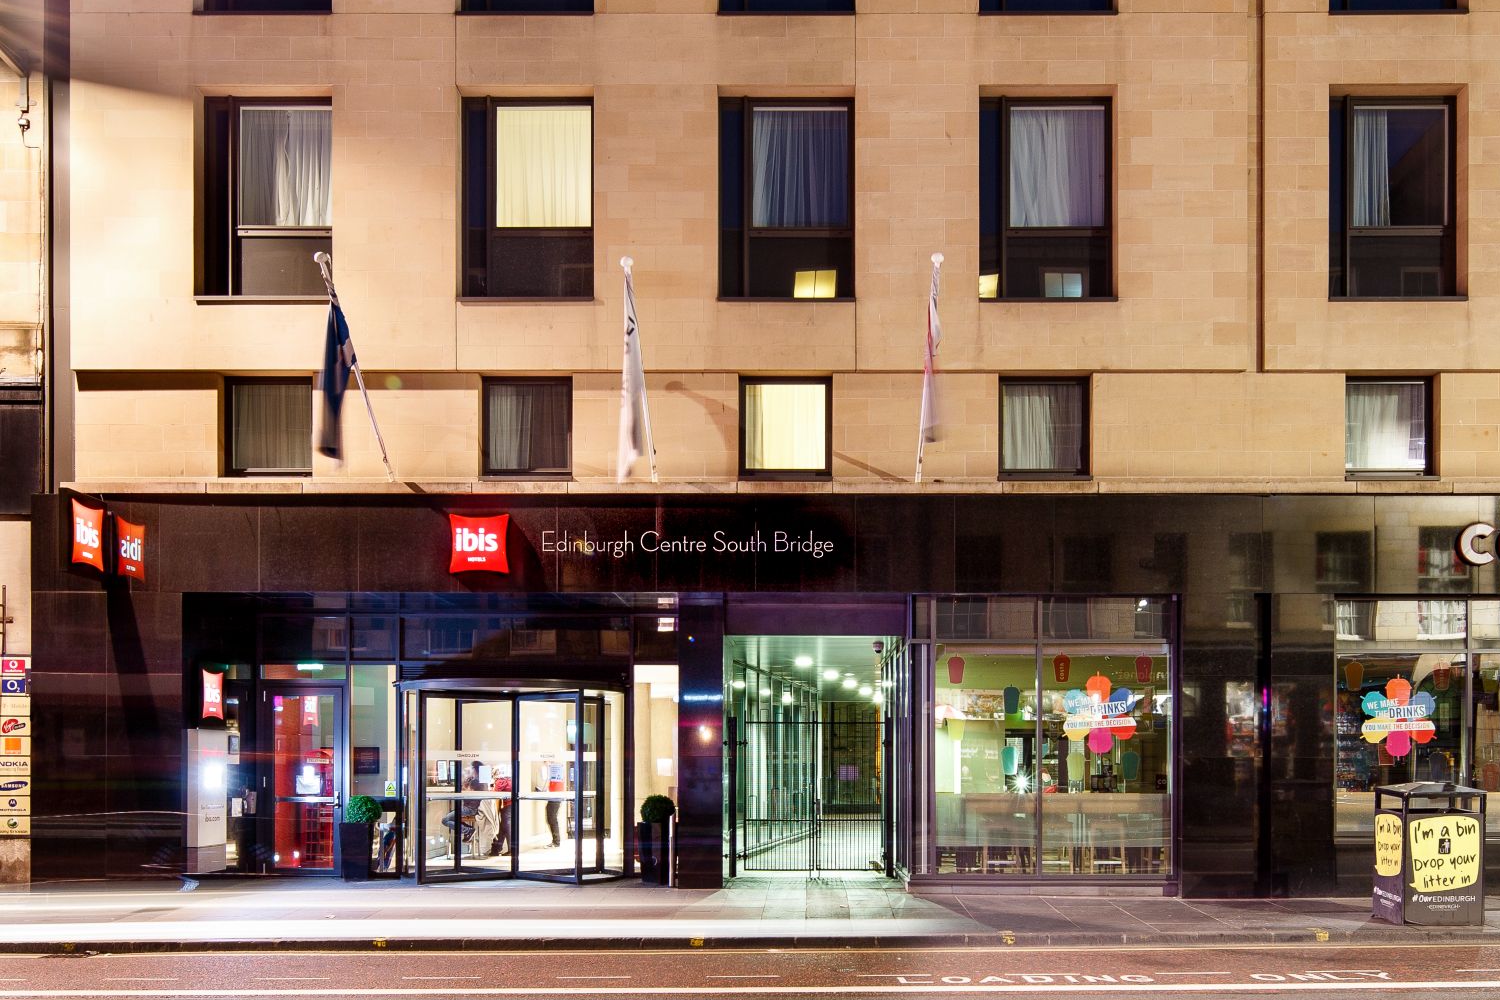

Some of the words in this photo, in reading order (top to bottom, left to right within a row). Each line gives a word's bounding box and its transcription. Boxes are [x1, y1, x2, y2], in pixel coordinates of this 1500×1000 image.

[75, 517, 99, 549] ibis
[455, 527, 498, 552] ibis
[542, 530, 634, 558] Edinburgh
[640, 530, 707, 552] Centre
[712, 530, 767, 552] South
[774, 530, 834, 559] Bridge
[1367, 702, 1379, 710] WE
[1380, 698, 1400, 708] MAKE
[1389, 705, 1425, 719] DRINKS
[1414, 822, 1434, 843] I'm
[1441, 825, 1450, 837] a
[1456, 818, 1476, 837] bin
[1378, 841, 1390, 851] Drop
[1390, 841, 1401, 854] your
[1414, 858, 1445, 871] Drop
[1450, 854, 1477, 869] your
[1424, 874, 1455, 888] litter
[1461, 870, 1471, 884] in
[897, 974, 1154, 984] LOADING
[1249, 971, 1392, 981] ONLY
